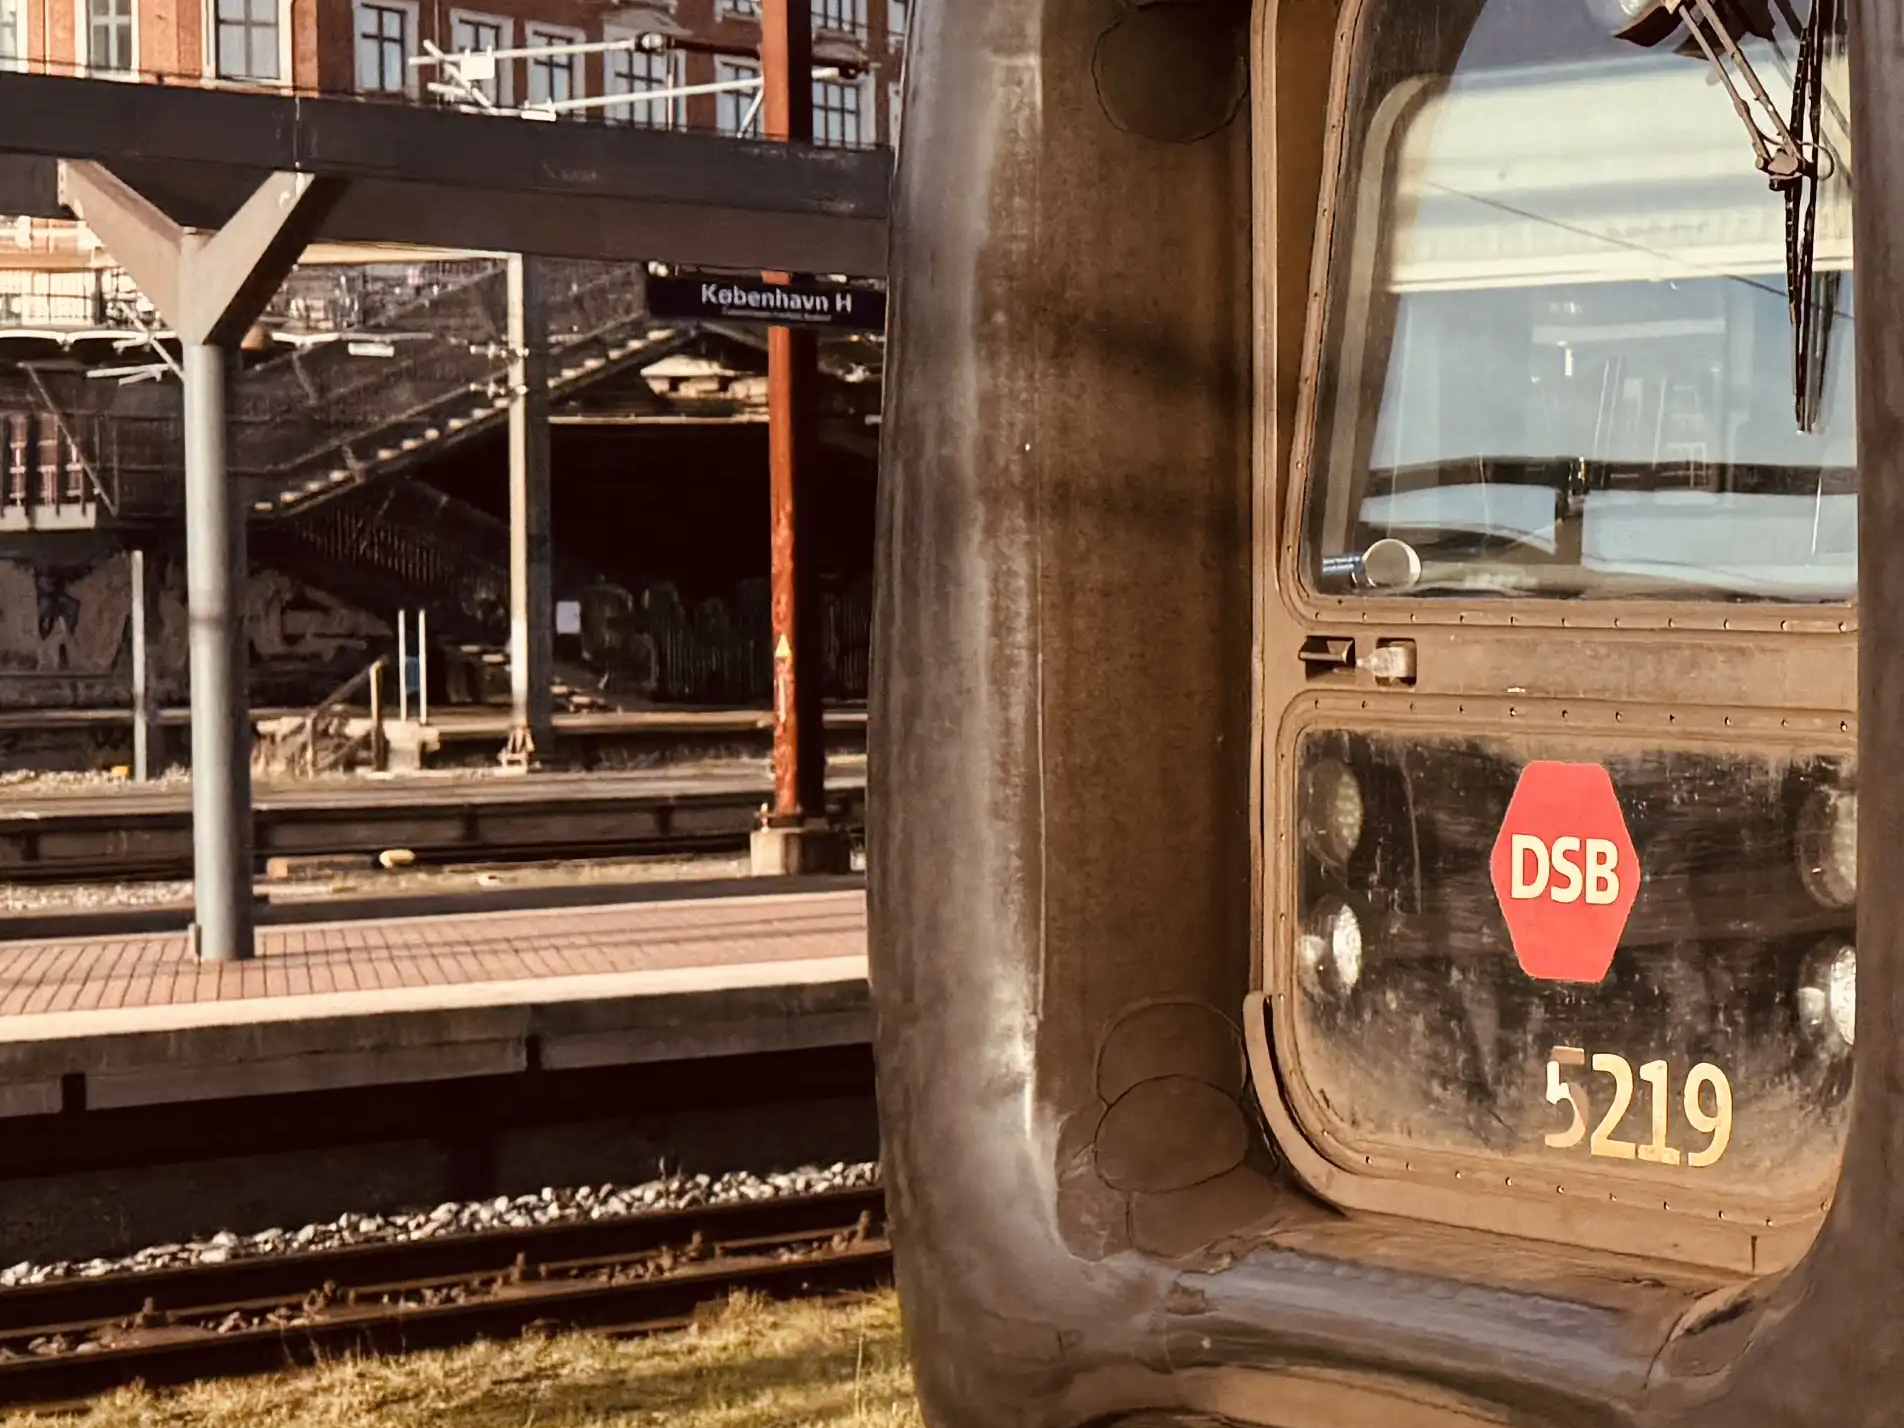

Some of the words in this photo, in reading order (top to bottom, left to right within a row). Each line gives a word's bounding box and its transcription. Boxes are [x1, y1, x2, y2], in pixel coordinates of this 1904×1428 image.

[701, 283, 829, 312] København
[836, 292, 853, 312] H
[1511, 833, 1620, 904] DSB
[1544, 1045, 1733, 1167] 5219
